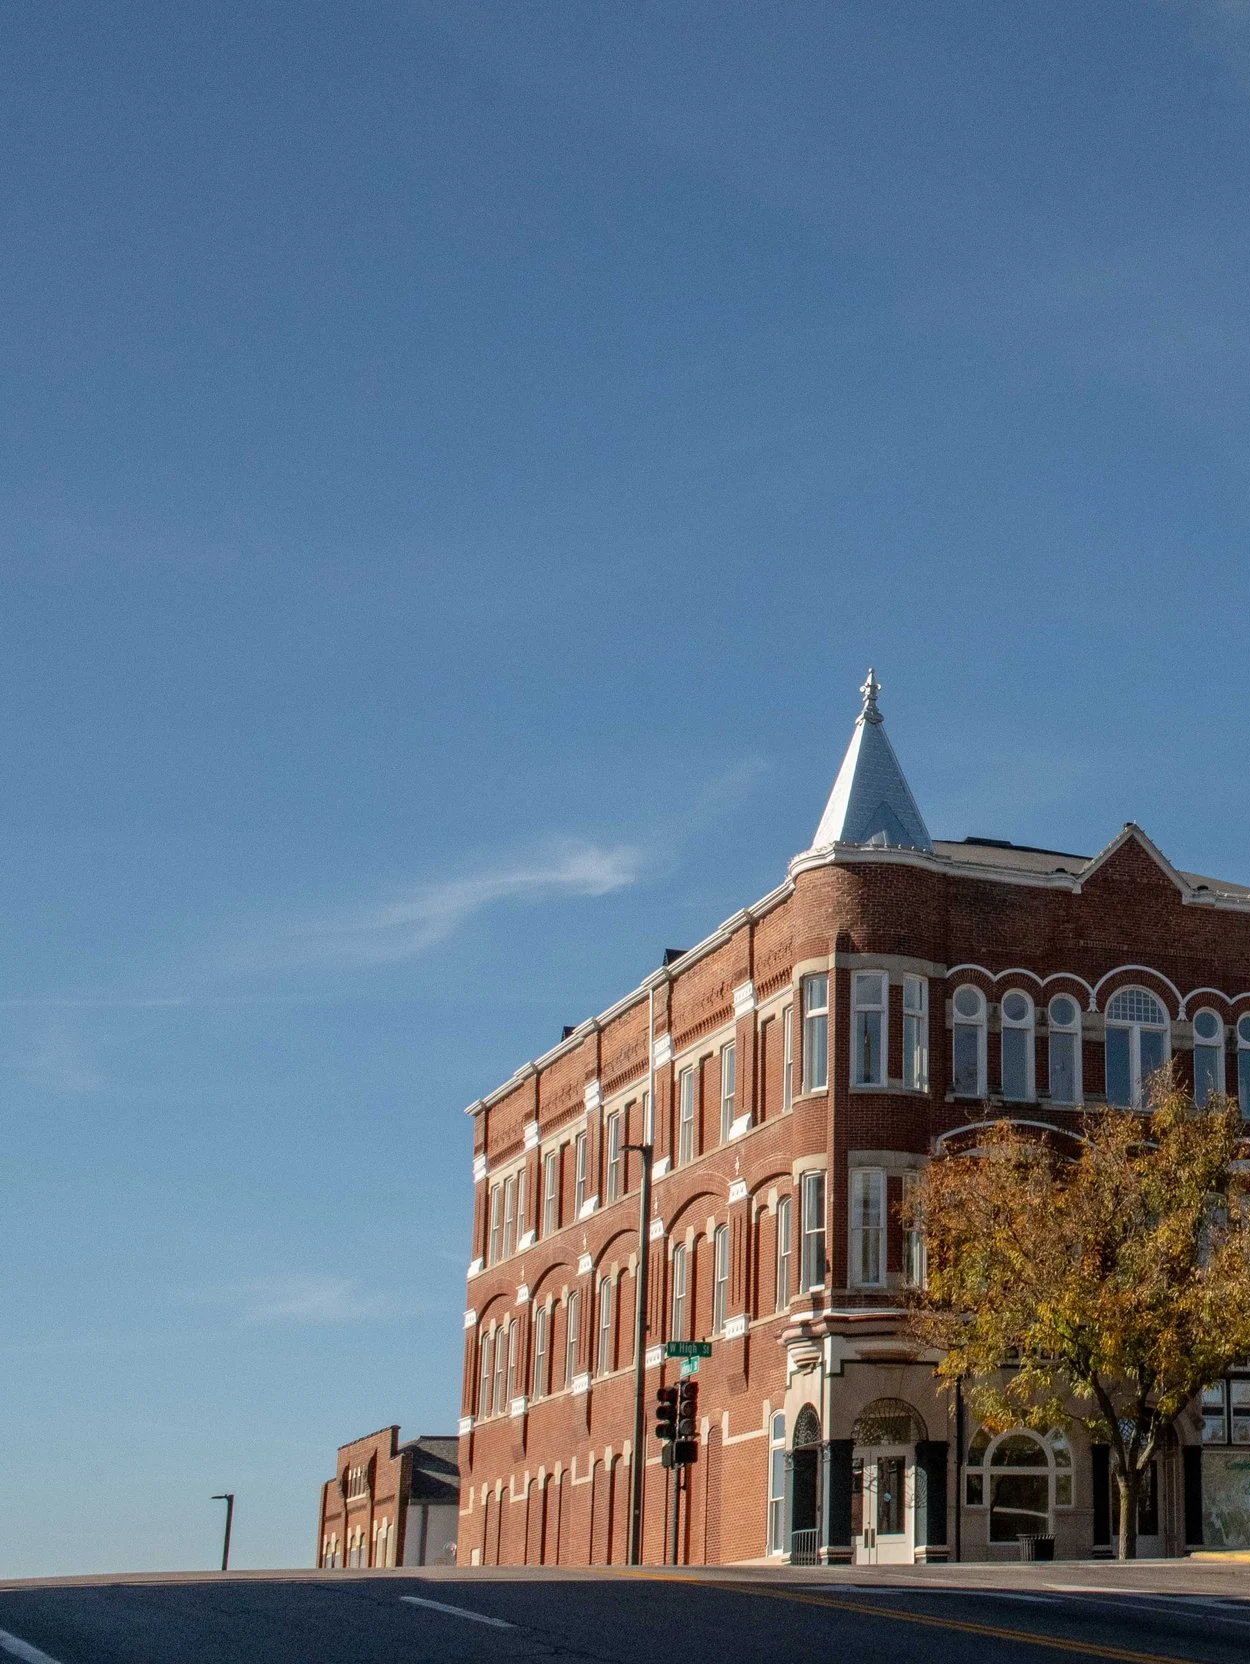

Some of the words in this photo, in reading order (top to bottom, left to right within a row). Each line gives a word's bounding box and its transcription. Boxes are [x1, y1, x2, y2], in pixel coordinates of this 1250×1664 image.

[669, 1342, 677, 1353] W
[679, 1342, 698, 1356] High
[702, 1344, 710, 1354] St
